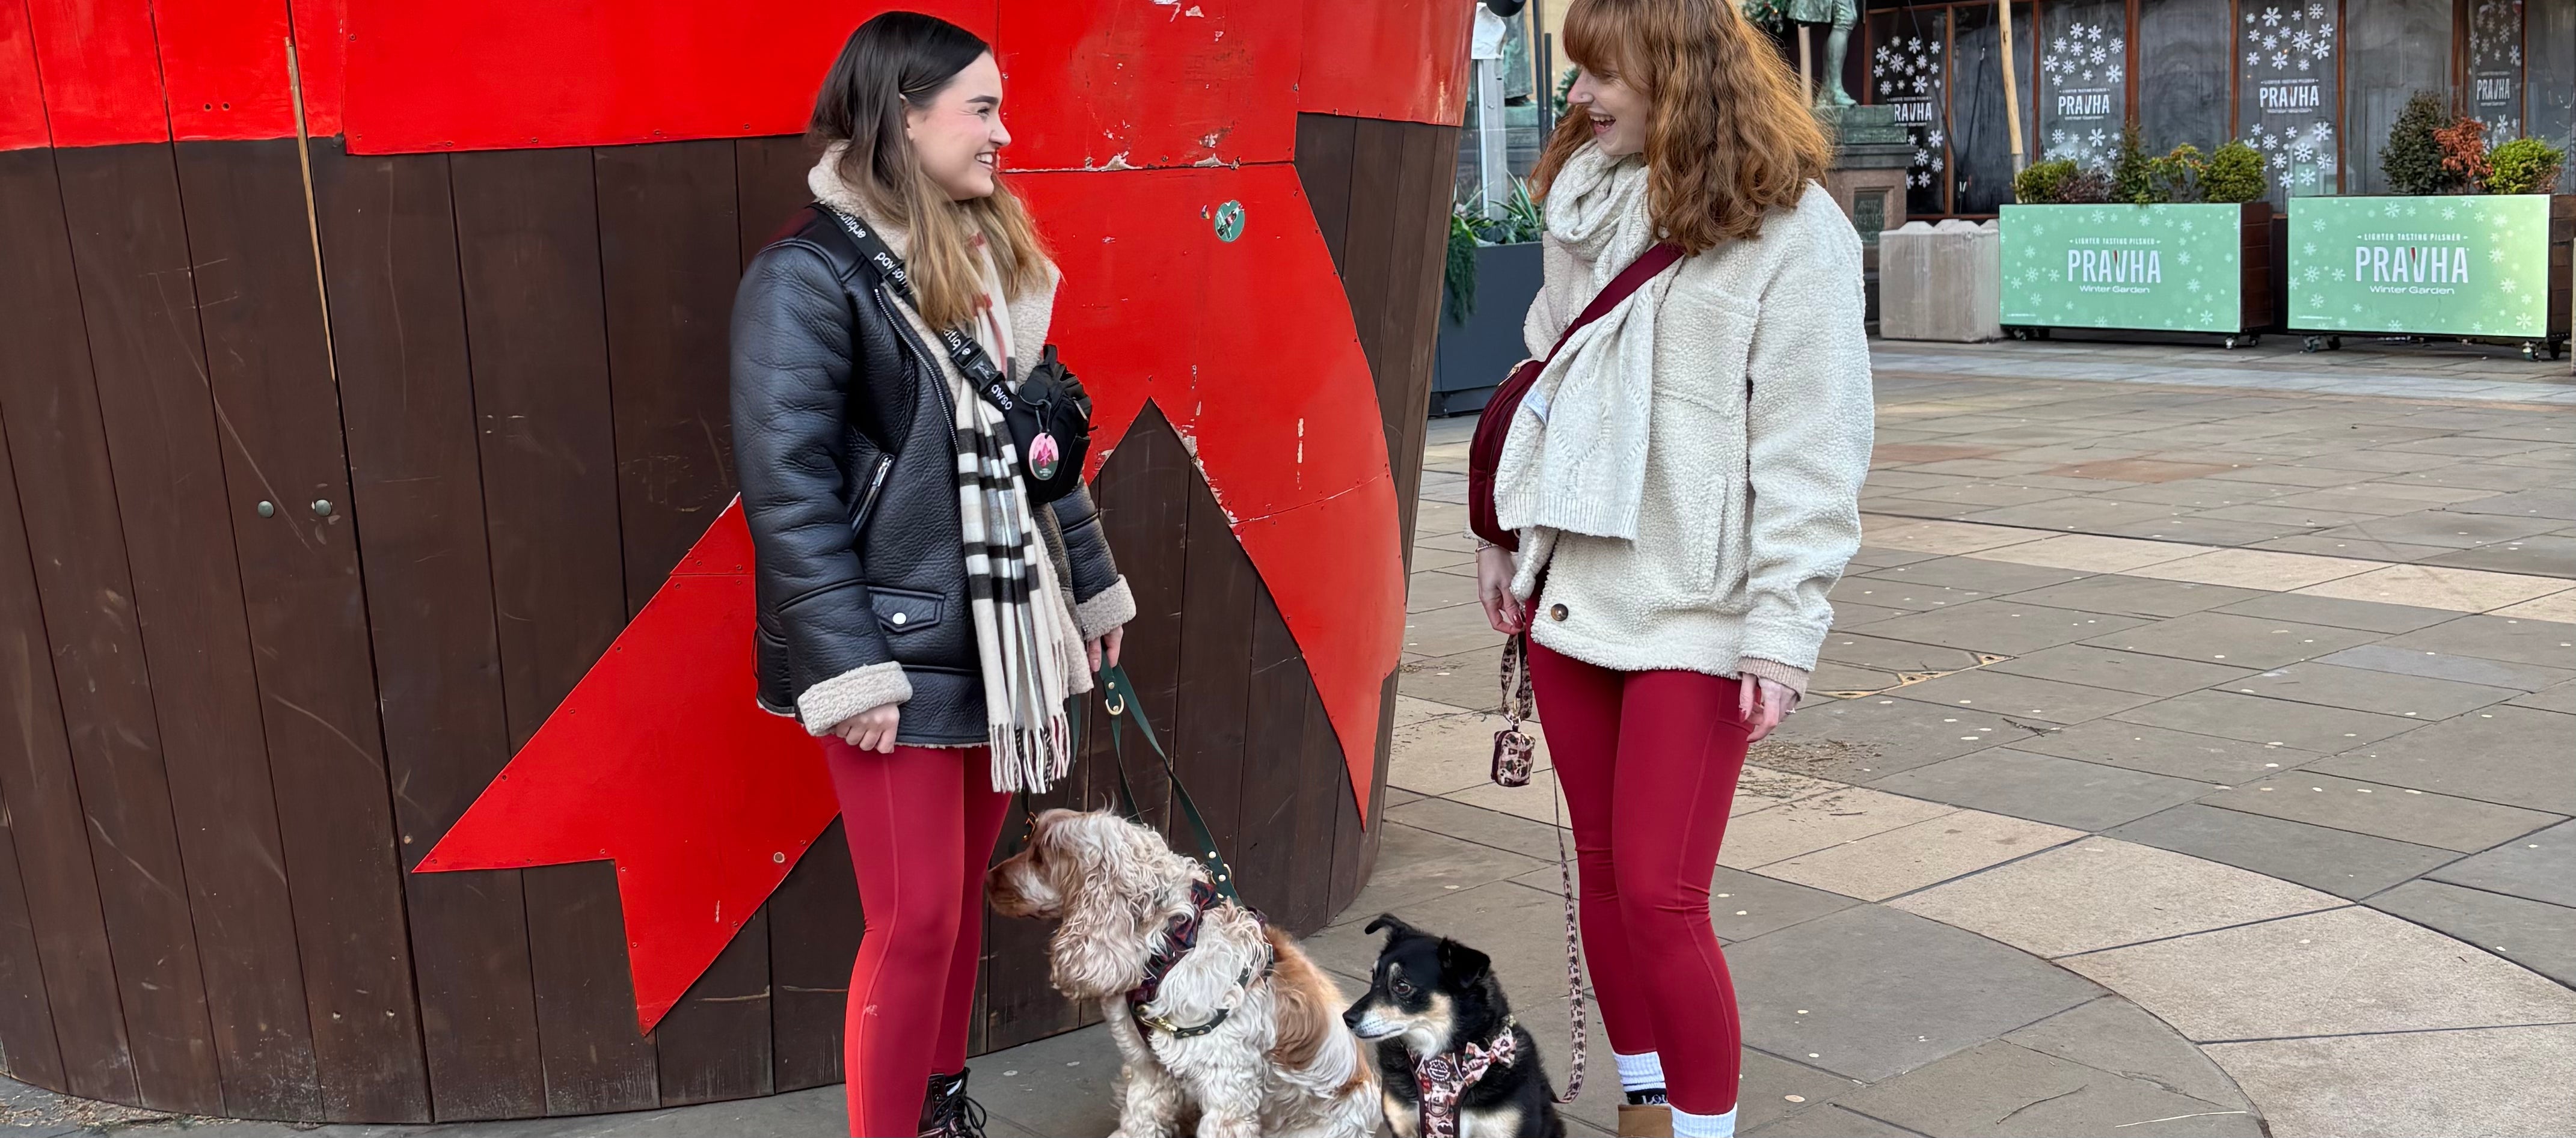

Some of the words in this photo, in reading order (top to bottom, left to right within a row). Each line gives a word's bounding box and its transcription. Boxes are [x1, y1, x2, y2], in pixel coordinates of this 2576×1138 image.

[2260, 85, 2319, 108] PRAVHA
[2477, 78, 2510, 101] PRAVHA
[1894, 102, 1933, 122] RAVHA
[2058, 94, 2110, 115] PRAVHA
[2068, 249, 2161, 283] PRAVHA
[2356, 246, 2468, 283] PRAVHA
[2370, 286, 2408, 294] Winter
[2409, 286, 2455, 295] Garden
[991, 384, 1013, 410] awso
